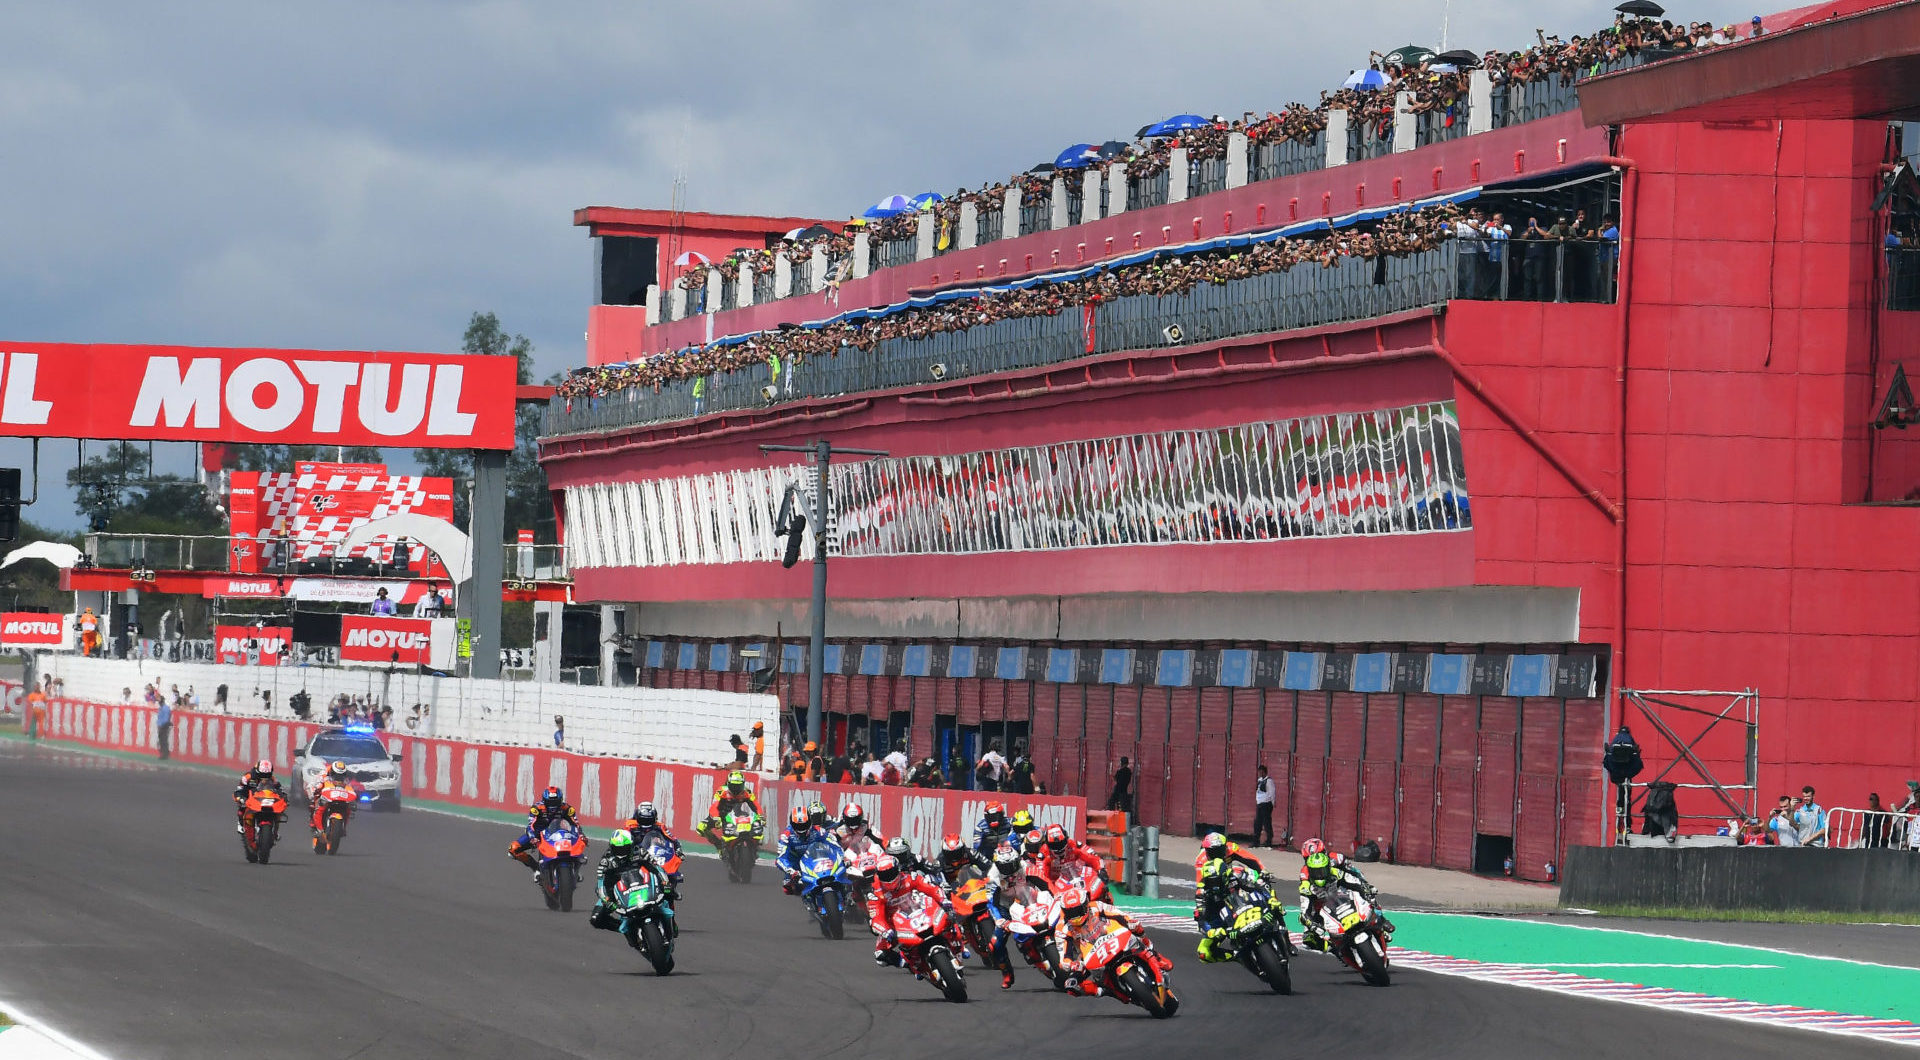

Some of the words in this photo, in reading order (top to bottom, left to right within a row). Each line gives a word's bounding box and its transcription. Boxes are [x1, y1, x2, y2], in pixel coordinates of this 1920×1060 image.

[130, 356, 477, 435] MOTUL
[228, 582, 272, 593] MOTUL
[4, 621, 60, 635] MOTUL
[345, 628, 429, 649] MOTUL
[813, 860, 834, 873] 42
[1234, 906, 1261, 930] 46
[1096, 936, 1120, 965] 93
